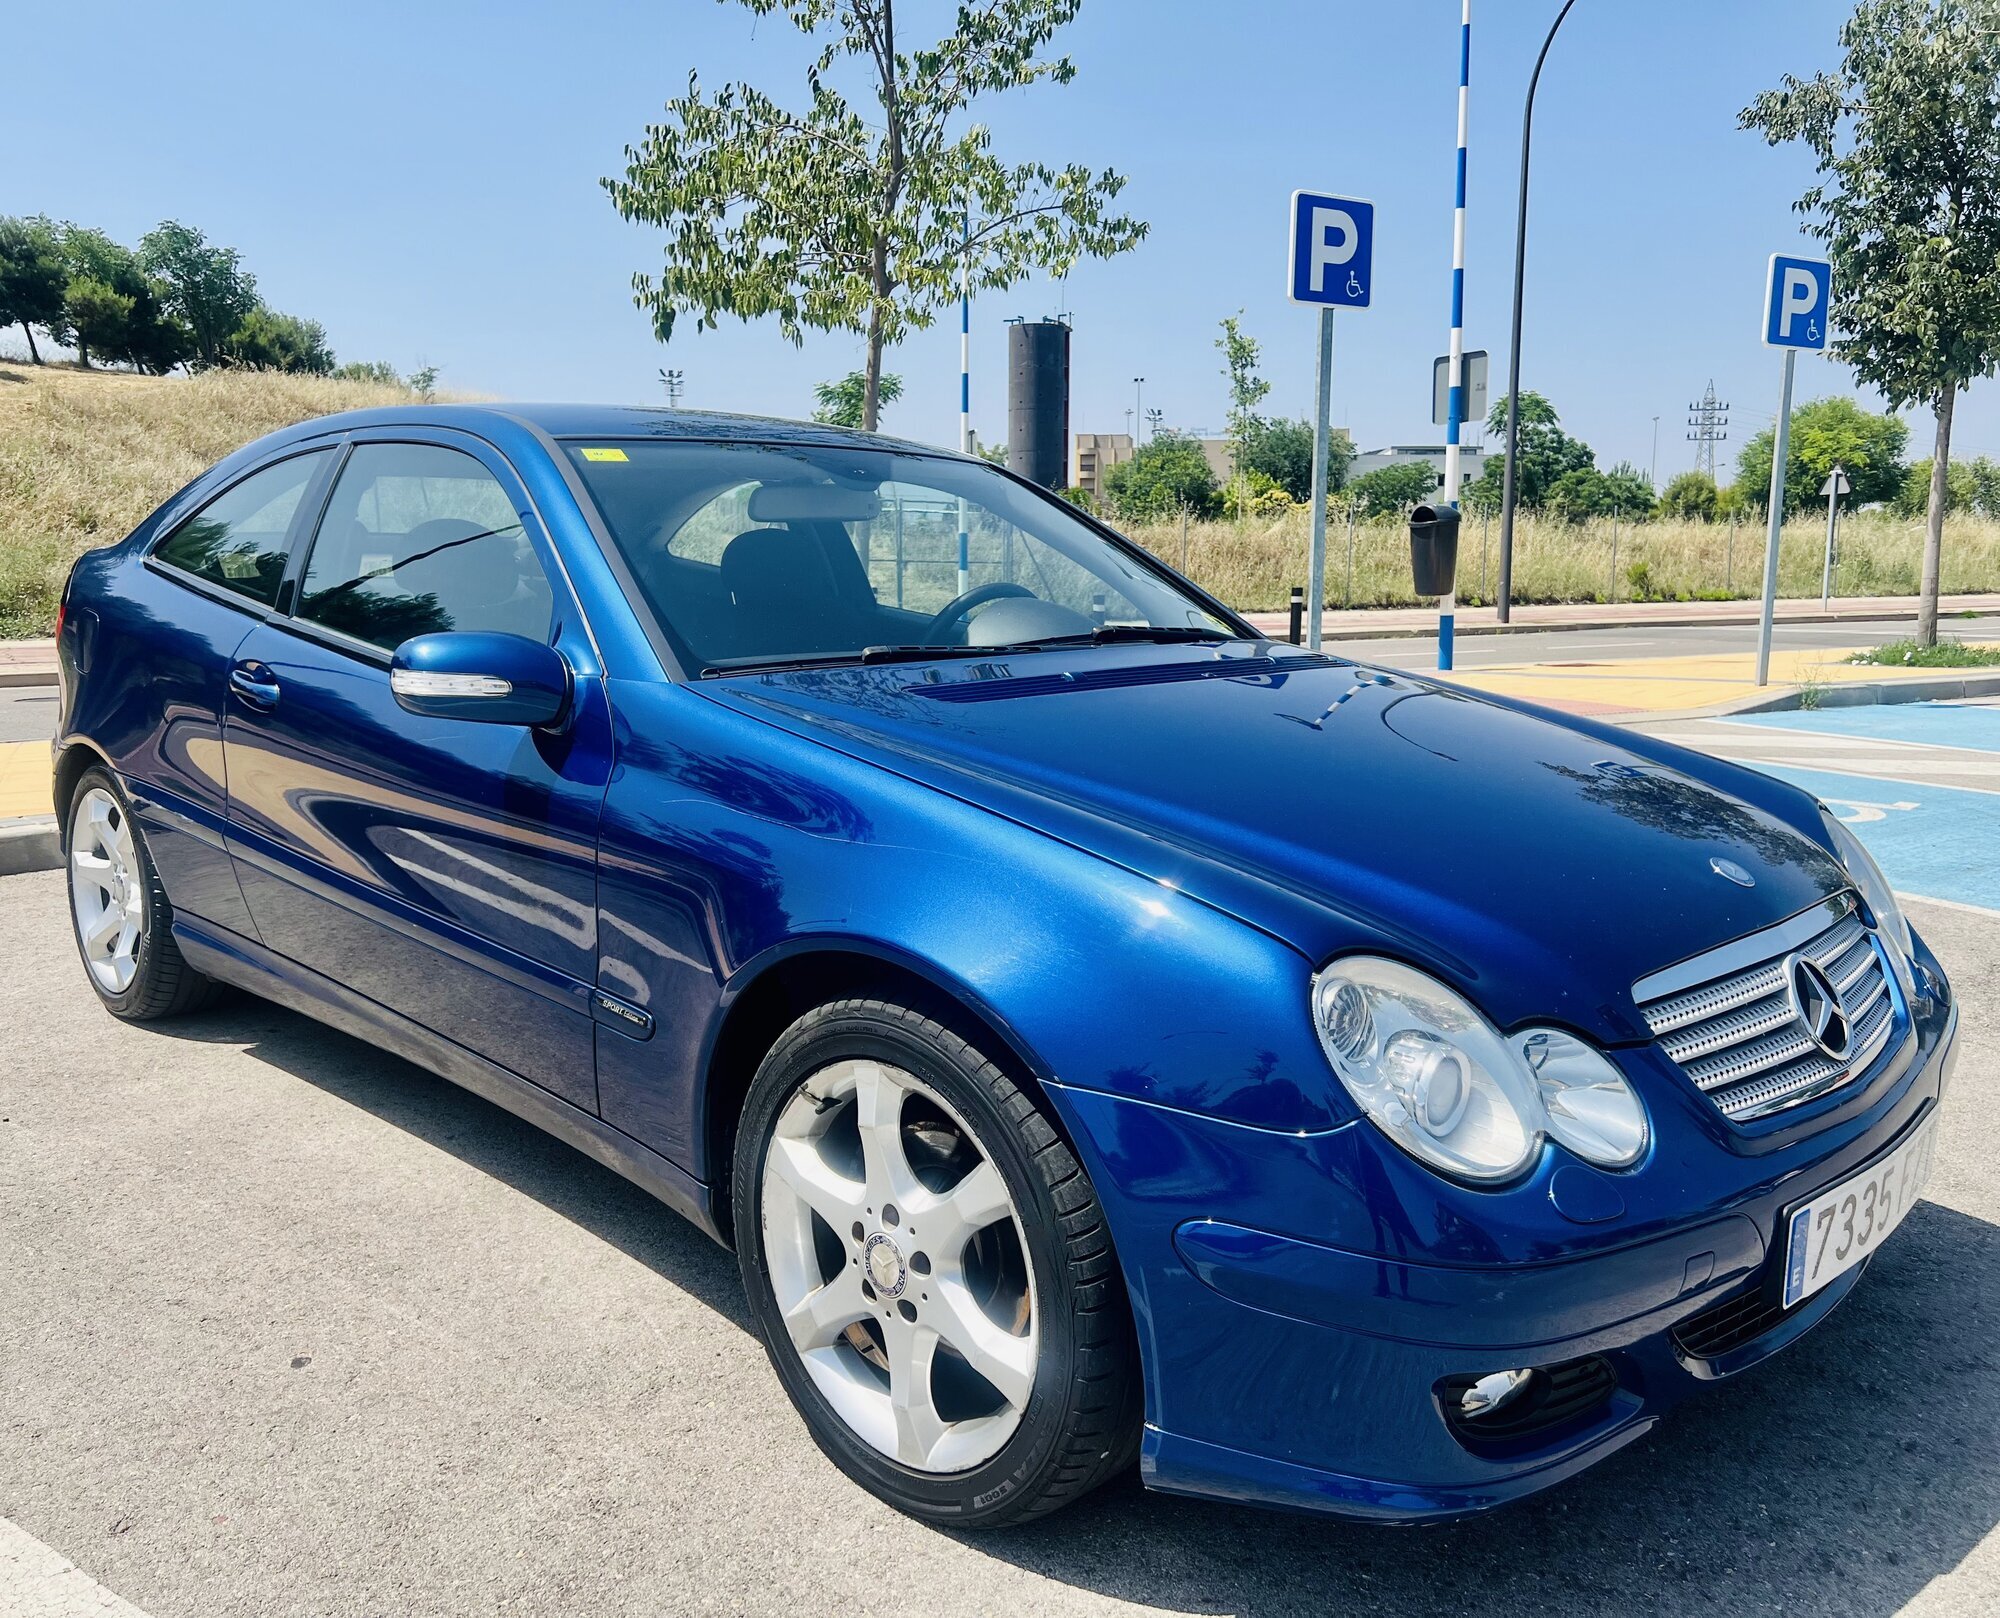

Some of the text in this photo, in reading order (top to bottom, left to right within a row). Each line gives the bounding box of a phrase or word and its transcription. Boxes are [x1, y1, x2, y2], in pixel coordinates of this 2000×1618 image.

[1309, 206, 1358, 292] P
[1779, 267, 1819, 337] P
[1812, 1165, 1895, 1280] 7335
[1792, 1265, 1801, 1288] E
